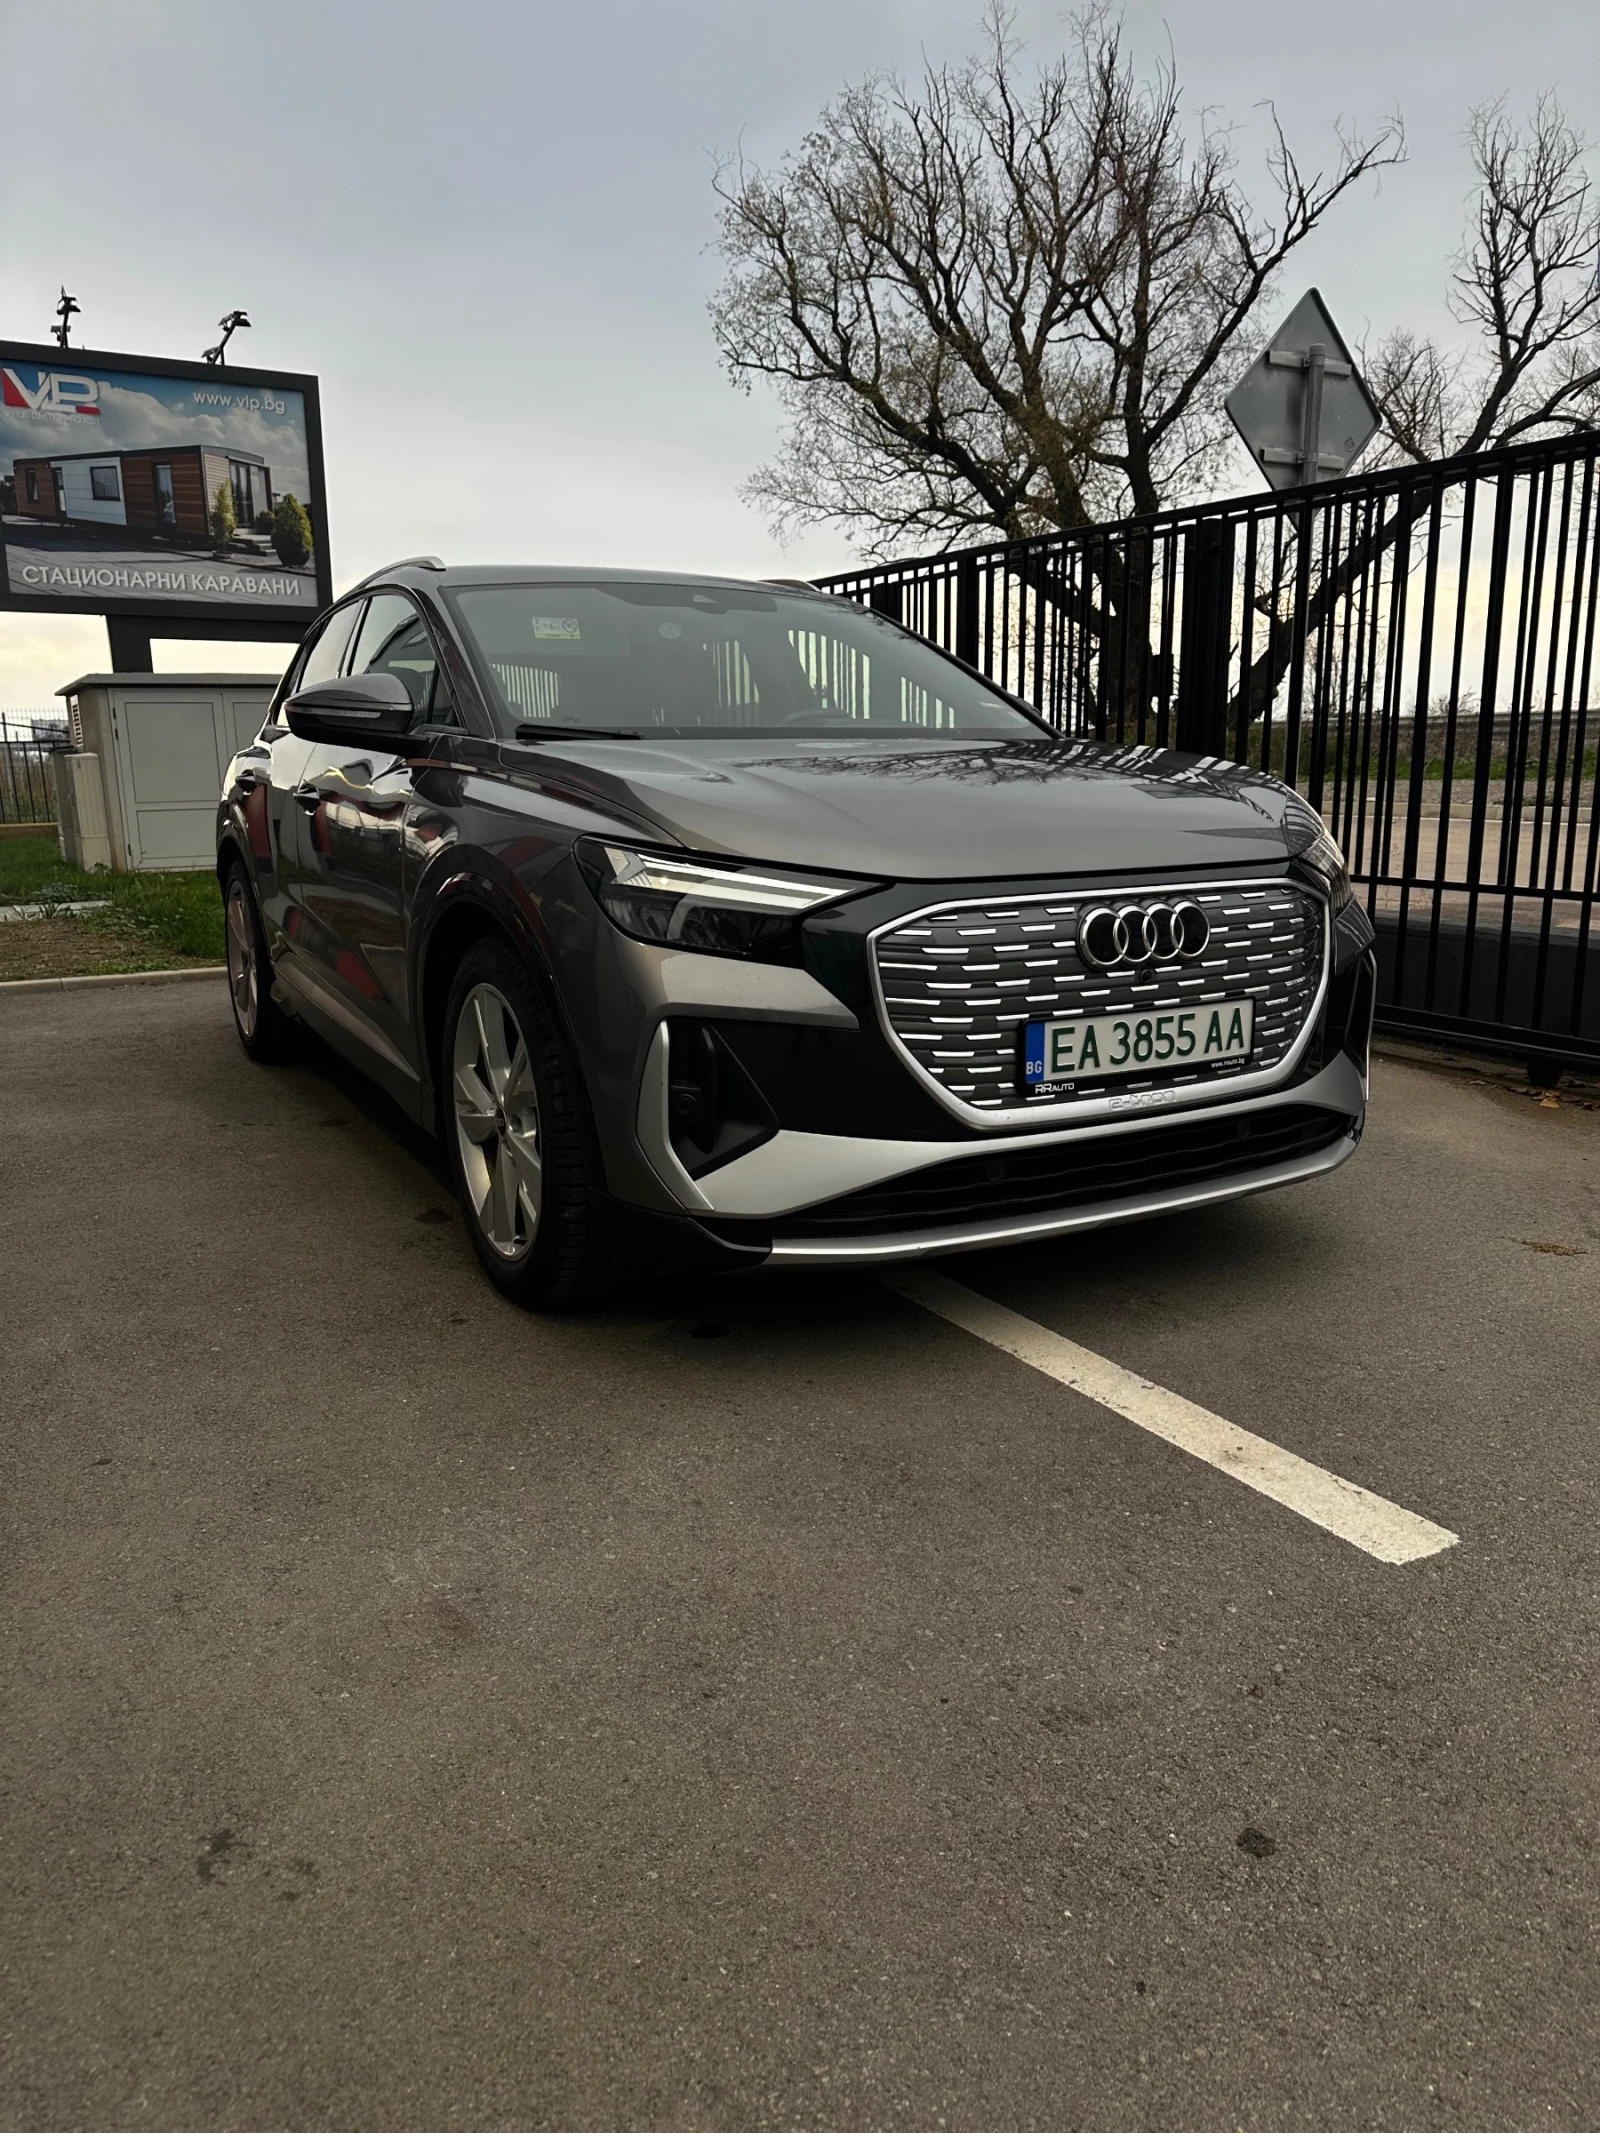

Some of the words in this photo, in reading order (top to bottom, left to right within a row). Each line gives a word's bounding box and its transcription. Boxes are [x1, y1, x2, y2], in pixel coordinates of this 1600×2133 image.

[193, 392, 285, 415] www.vlp.bg
[22, 565, 186, 590] СТАЦИОНАРНИ
[191, 573, 300, 596] КАРАВАНИ
[1051, 1024, 1101, 1074] EA
[1109, 1012, 1196, 1066] 3855
[1203, 1007, 1245, 1055] AA
[1025, 1061, 1043, 1075] BG
